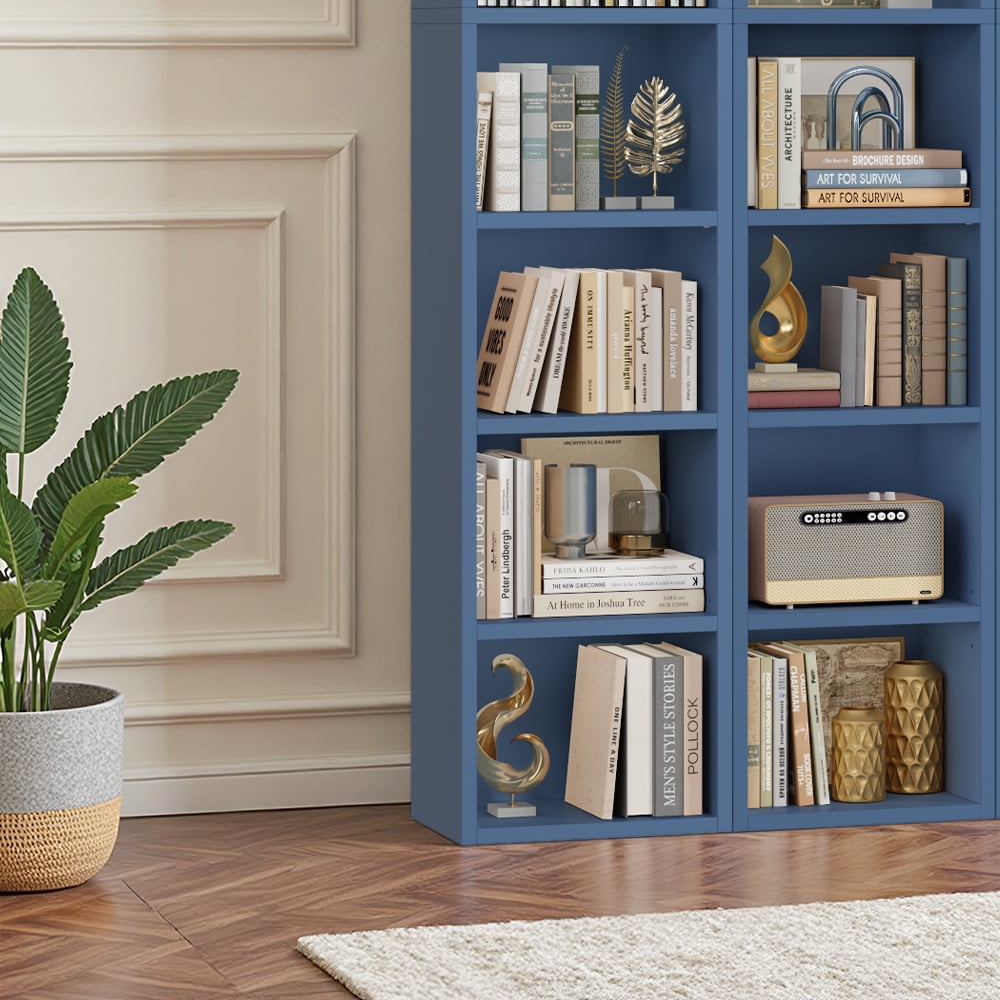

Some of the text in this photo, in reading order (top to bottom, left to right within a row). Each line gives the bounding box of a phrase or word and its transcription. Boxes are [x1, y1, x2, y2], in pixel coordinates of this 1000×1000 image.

[479, 122, 487, 138] LOVE
[761, 69, 775, 189] ALL ABOUT YVES
[784, 87, 793, 161] ARCHITECTURE
[479, 138, 486, 149] WE
[852, 155, 925, 165] BROCHURE DESIGN
[817, 173, 902, 184] ART FOR SURVIVAL
[818, 193, 904, 203] ART FOR SURVIVAL
[587, 289, 593, 301] ON
[640, 284, 648, 301] The
[685, 292, 695, 312] Karen
[533, 353, 541, 363] for
[538, 312, 552, 347] sustainable
[546, 287, 559, 311] lifestyle
[636, 326, 649, 355] beyond
[683, 314, 695, 351] McCartney
[553, 306, 571, 379] DREAM AWAKE
[624, 309, 632, 391] Arianna Huffington
[669, 307, 678, 378] amanda lovelace
[501, 529, 512, 599] Peter Lindbergh
[579, 566, 606, 574] KAHLO
[547, 598, 645, 610] At Home in Joshua Tree
[790, 665, 801, 712] CHAPMAN
[663, 663, 675, 808] MEN'S STYLE STORIES
[687, 698, 699, 775] POLLOCK
